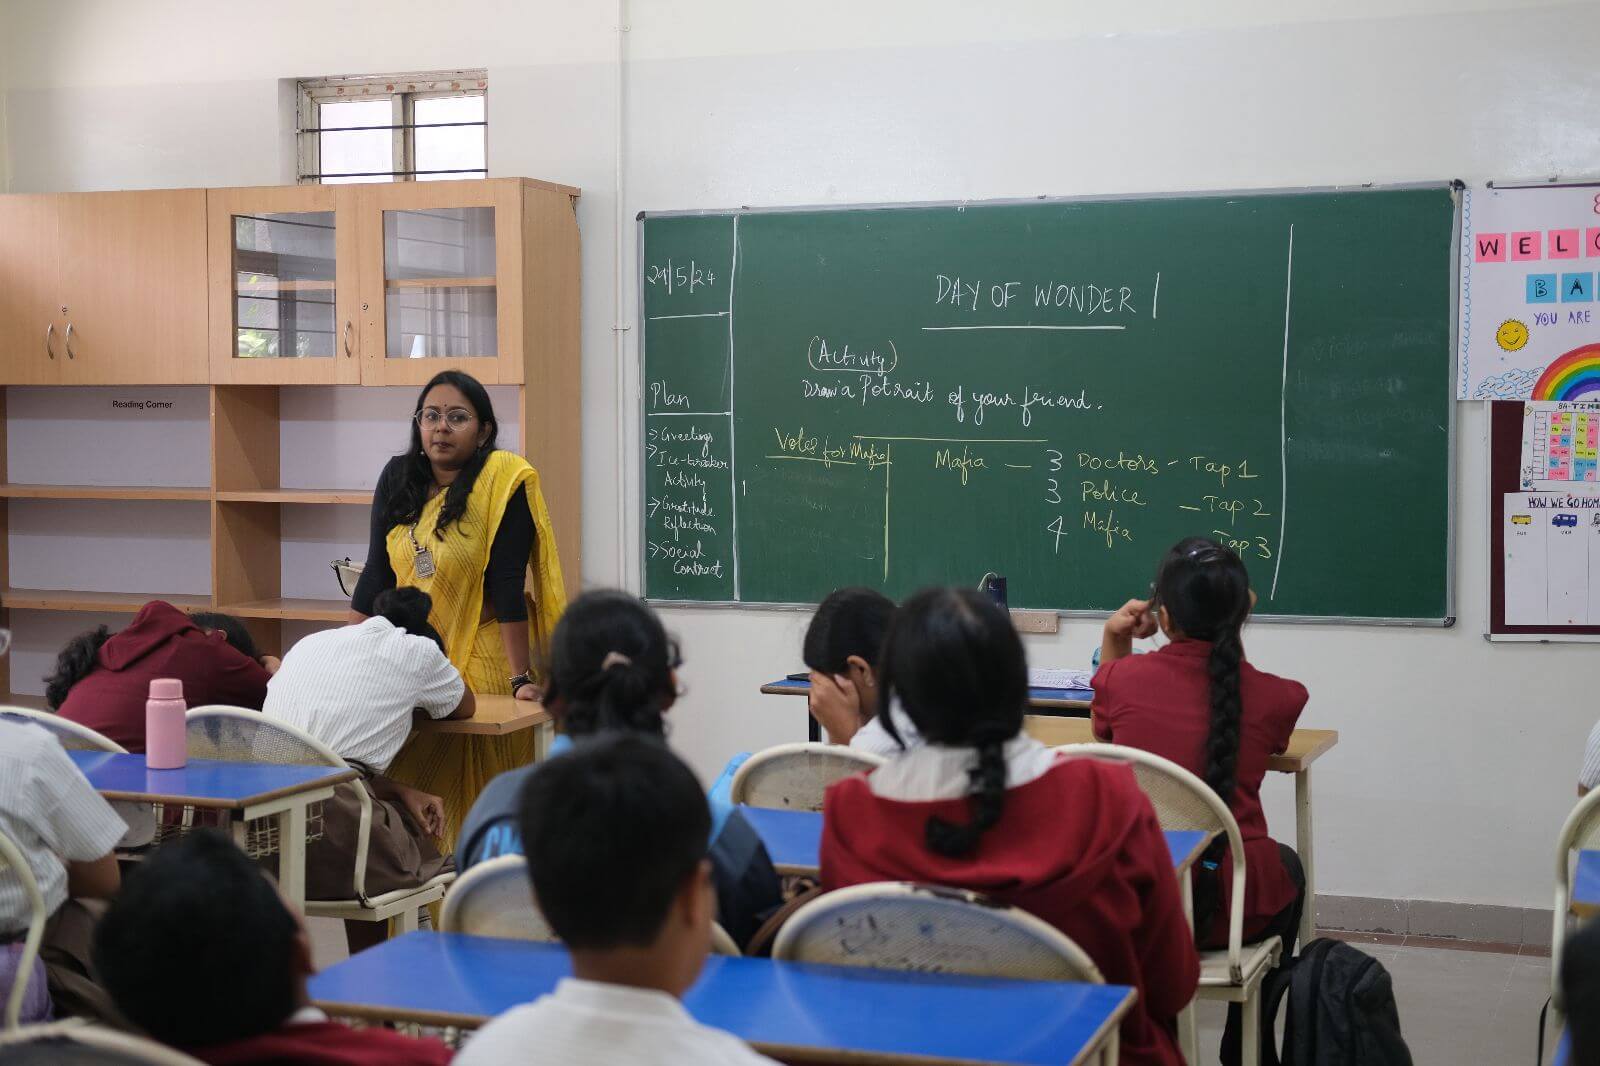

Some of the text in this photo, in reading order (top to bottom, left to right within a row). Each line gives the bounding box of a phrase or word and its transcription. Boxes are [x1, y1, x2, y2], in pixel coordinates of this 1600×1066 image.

[647, 259, 717, 295] 29/5/24
[936, 274, 981, 311] DAY
[991, 281, 1021, 308] OF
[1034, 281, 1137, 316] WONDER
[1533, 310, 1591, 326] YOU ARE
[112, 400, 173, 410] Reading Corner
[651, 379, 691, 409] Plan
[948, 385, 966, 422] of
[972, 392, 1016, 426] your
[661, 425, 713, 458] Greeting
[822, 435, 846, 469] for
[935, 446, 989, 485] Mafia
[1046, 450, 1063, 471] 3
[1077, 451, 1160, 476] Doctors
[1189, 456, 1232, 487] Tap
[1238, 460, 1258, 478] 1
[1045, 478, 1062, 503] 3
[1080, 480, 1147, 506] Police
[1202, 495, 1244, 526] Tap
[1252, 499, 1272, 516] 2
[1528, 496, 1600, 508] HOW WE GO HOM
[660, 540, 706, 560] Social
[1047, 510, 1272, 560] 4 Mafia Tap 3
[673, 559, 723, 579] Contract
